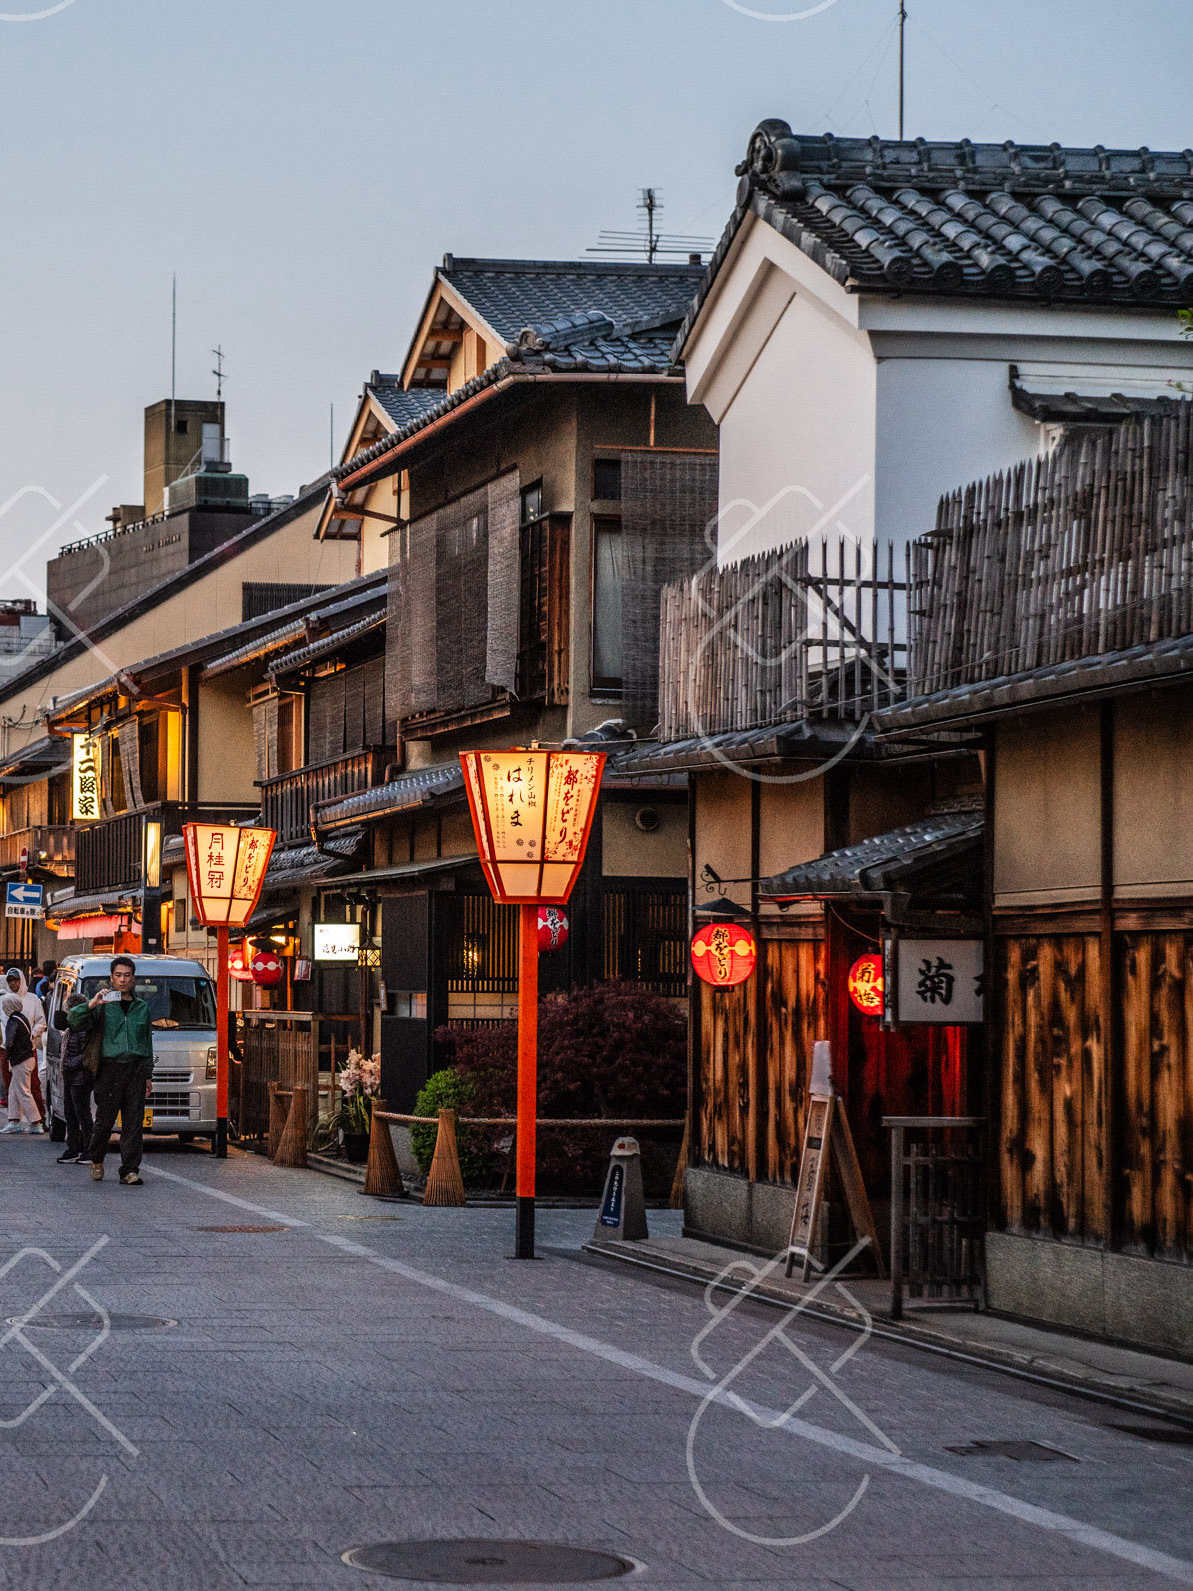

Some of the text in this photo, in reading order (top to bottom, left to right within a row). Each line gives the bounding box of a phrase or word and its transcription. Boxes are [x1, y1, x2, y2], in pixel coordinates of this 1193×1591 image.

[506, 765, 524, 827] はれま
[557, 765, 579, 845] 都をどり
[206, 832, 225, 889] 月桂冠
[242, 836, 259, 888] 都をどり
[711, 927, 729, 980] 都をどり
